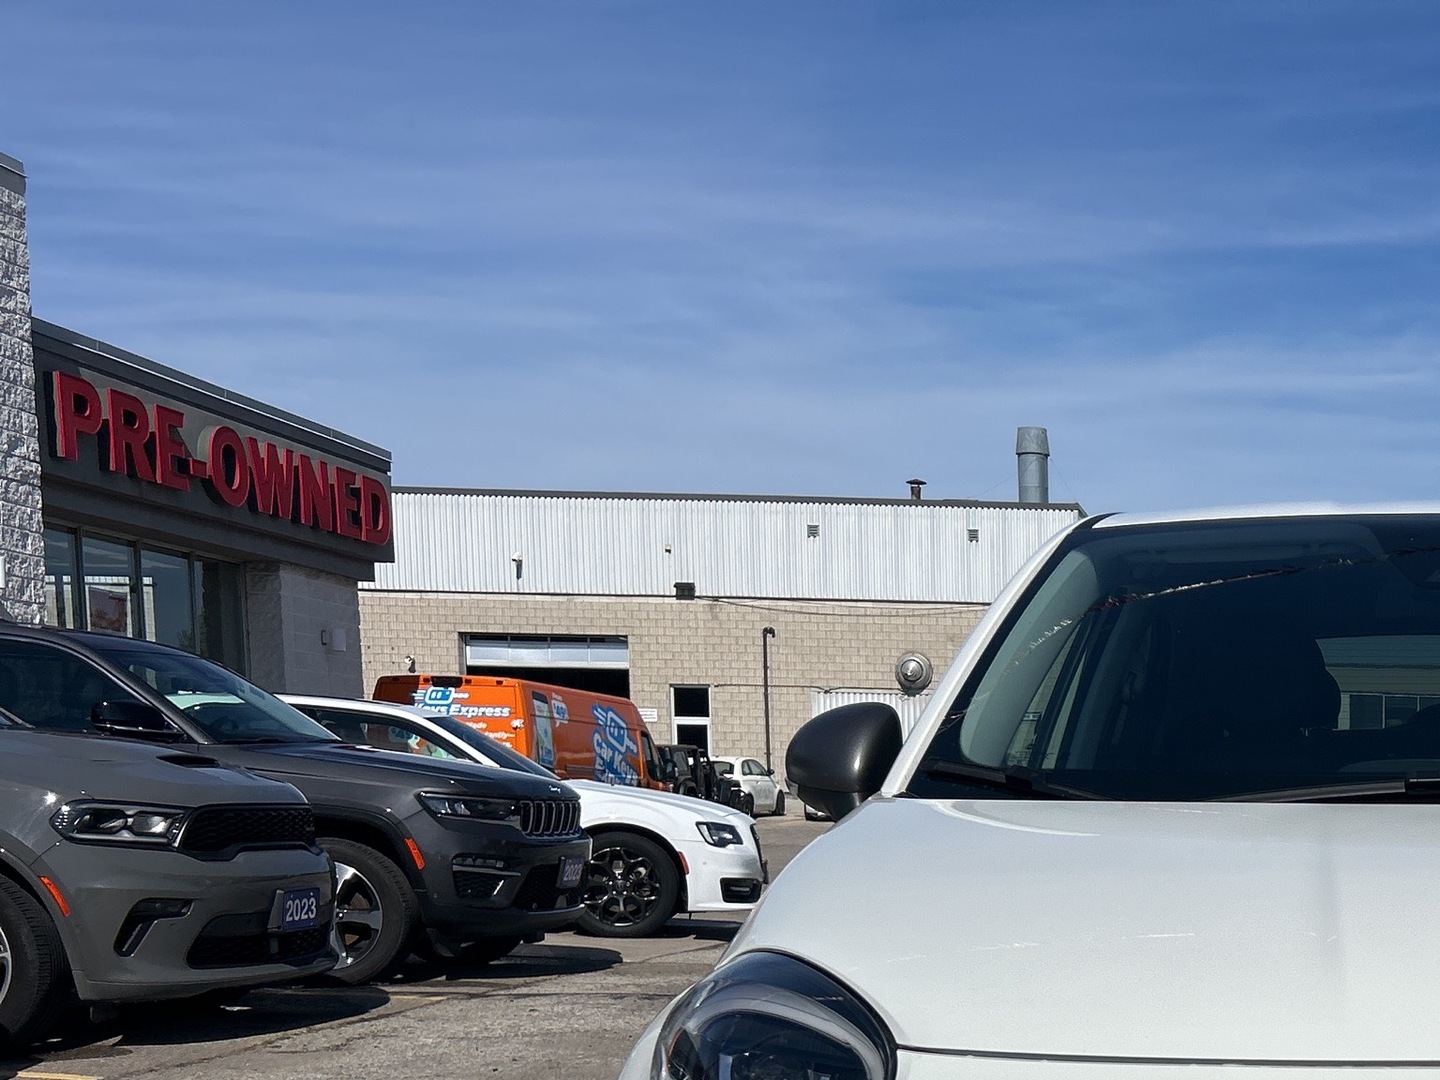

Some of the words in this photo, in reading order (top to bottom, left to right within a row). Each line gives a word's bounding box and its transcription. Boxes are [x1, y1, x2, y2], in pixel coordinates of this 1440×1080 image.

[54, 370, 391, 546] PRE-OWNED
[449, 703, 511, 718] Express
[593, 732, 613, 763] Car
[613, 751, 638, 787] Keys
[286, 897, 317, 922] 2023
